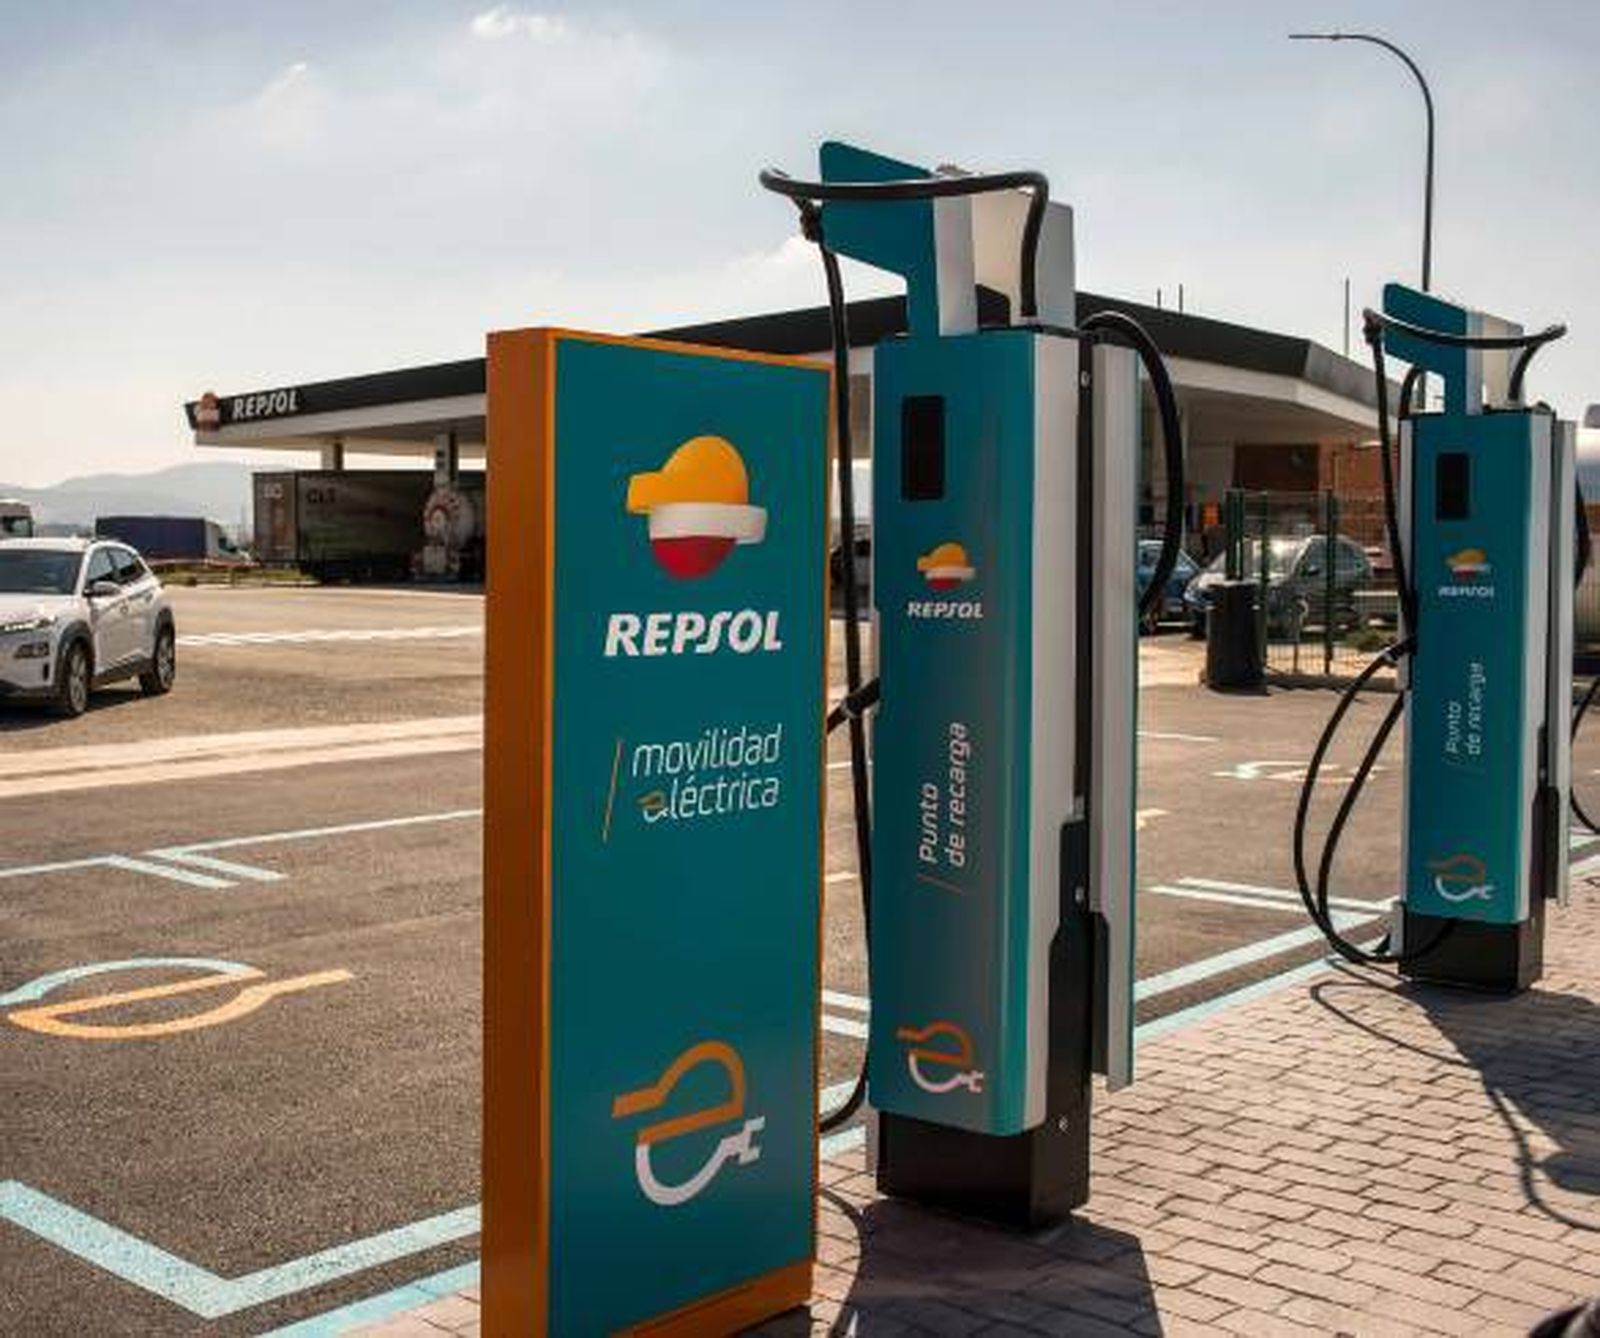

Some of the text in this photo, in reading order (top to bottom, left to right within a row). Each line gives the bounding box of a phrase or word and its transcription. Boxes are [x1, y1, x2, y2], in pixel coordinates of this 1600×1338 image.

[232, 389, 299, 420] REPSOL
[604, 608, 783, 657] REPSOL
[907, 601, 984, 619] REPSOL
[632, 722, 783, 778] movilidad
[635, 772, 781, 823] eléctrica
[944, 721, 971, 868] de recarga
[918, 782, 939, 865] Punto
